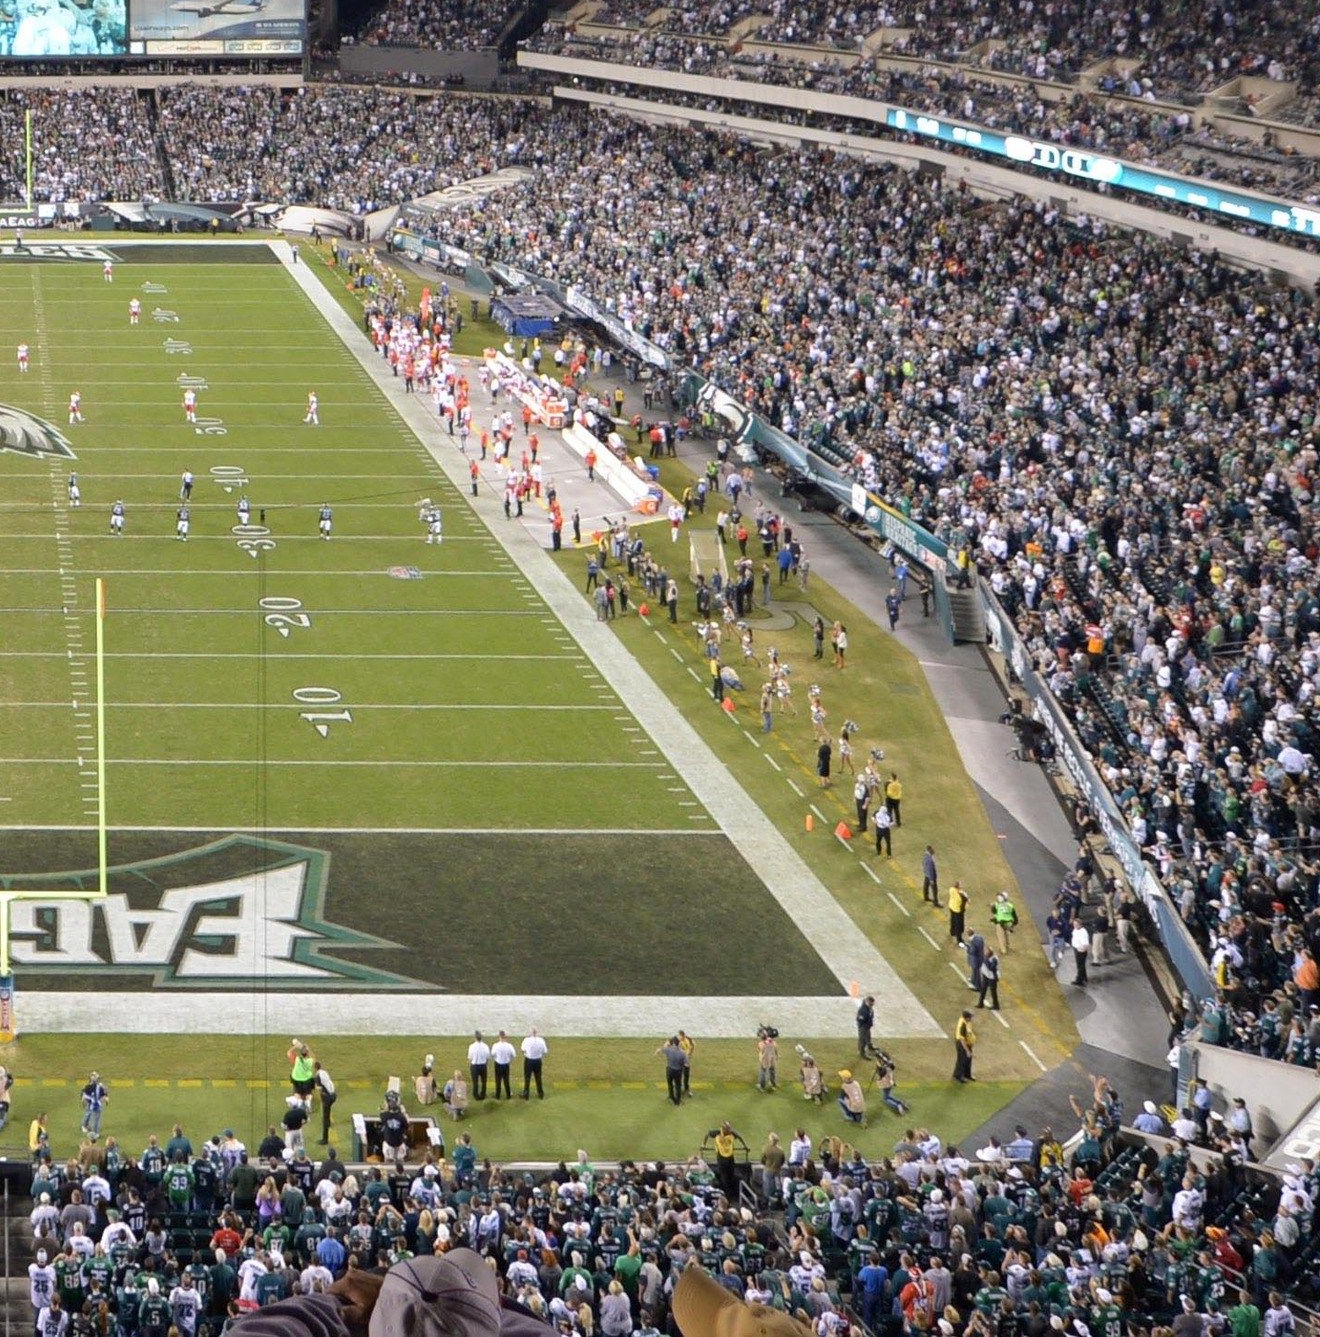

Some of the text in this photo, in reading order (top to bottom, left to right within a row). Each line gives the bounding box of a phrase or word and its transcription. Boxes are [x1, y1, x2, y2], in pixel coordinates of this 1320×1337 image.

[210, 466, 249, 487] 40
[232, 525, 277, 549] 30
[259, 597, 310, 628] 20
[293, 687, 353, 723] 10
[170, 1175, 188, 1190] 99
[199, 1172, 207, 1187] 5
[151, 1310, 160, 1326] 5
